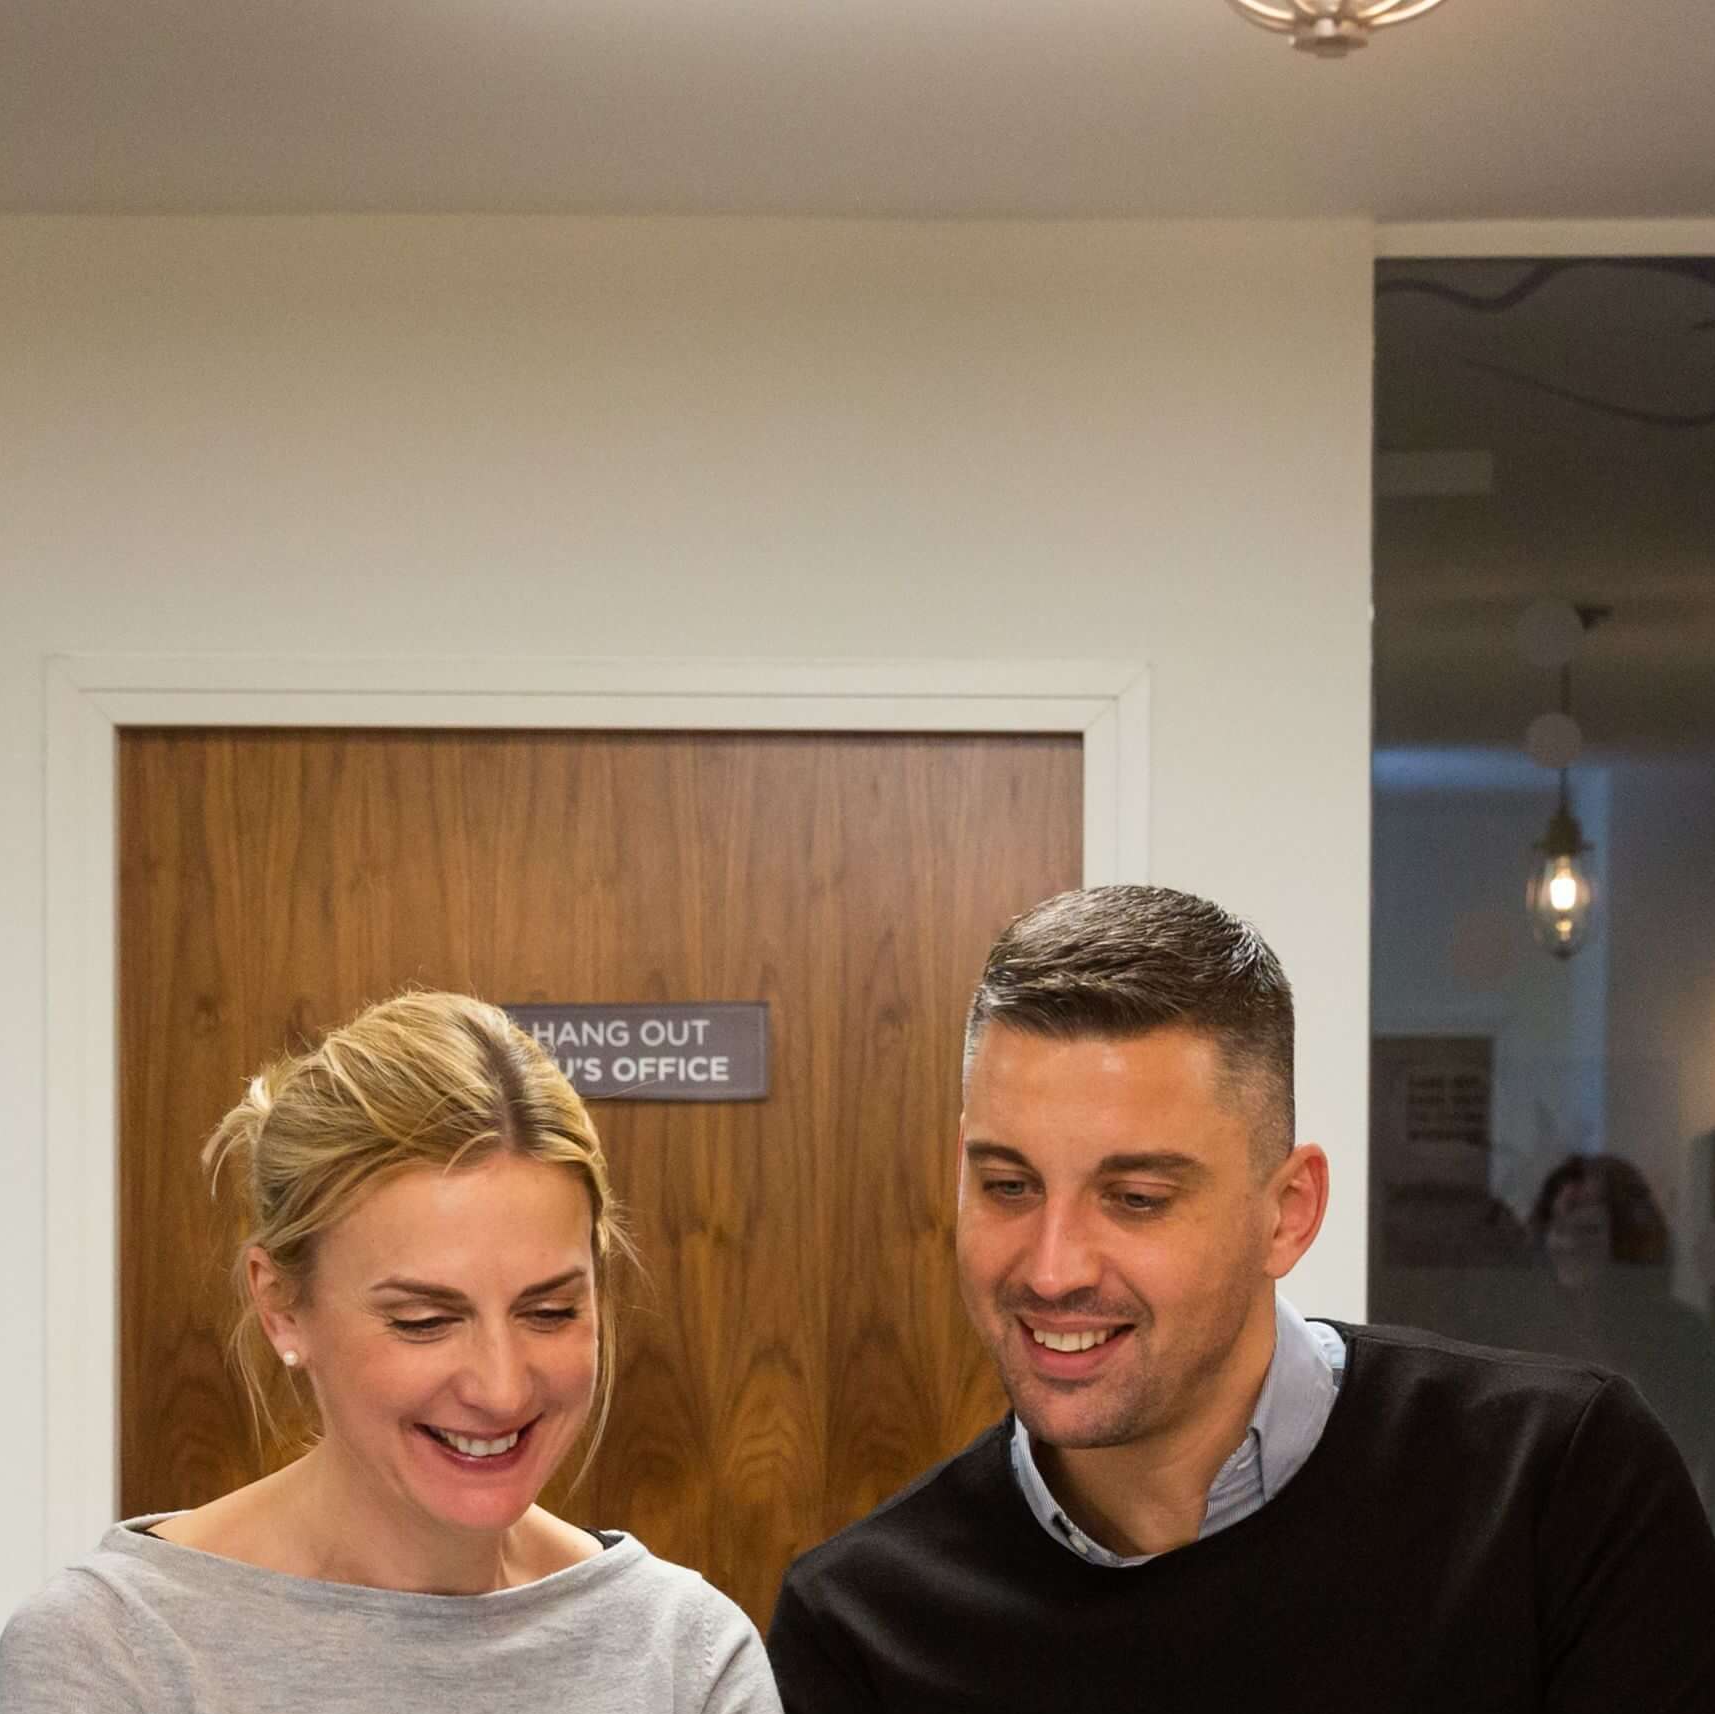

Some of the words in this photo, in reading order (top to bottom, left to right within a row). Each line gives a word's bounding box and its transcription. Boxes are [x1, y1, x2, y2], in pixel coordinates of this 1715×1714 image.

[533, 1020, 630, 1047] HANG
[639, 1019, 710, 1047] OUT
[611, 1056, 729, 1082] OFFICE
